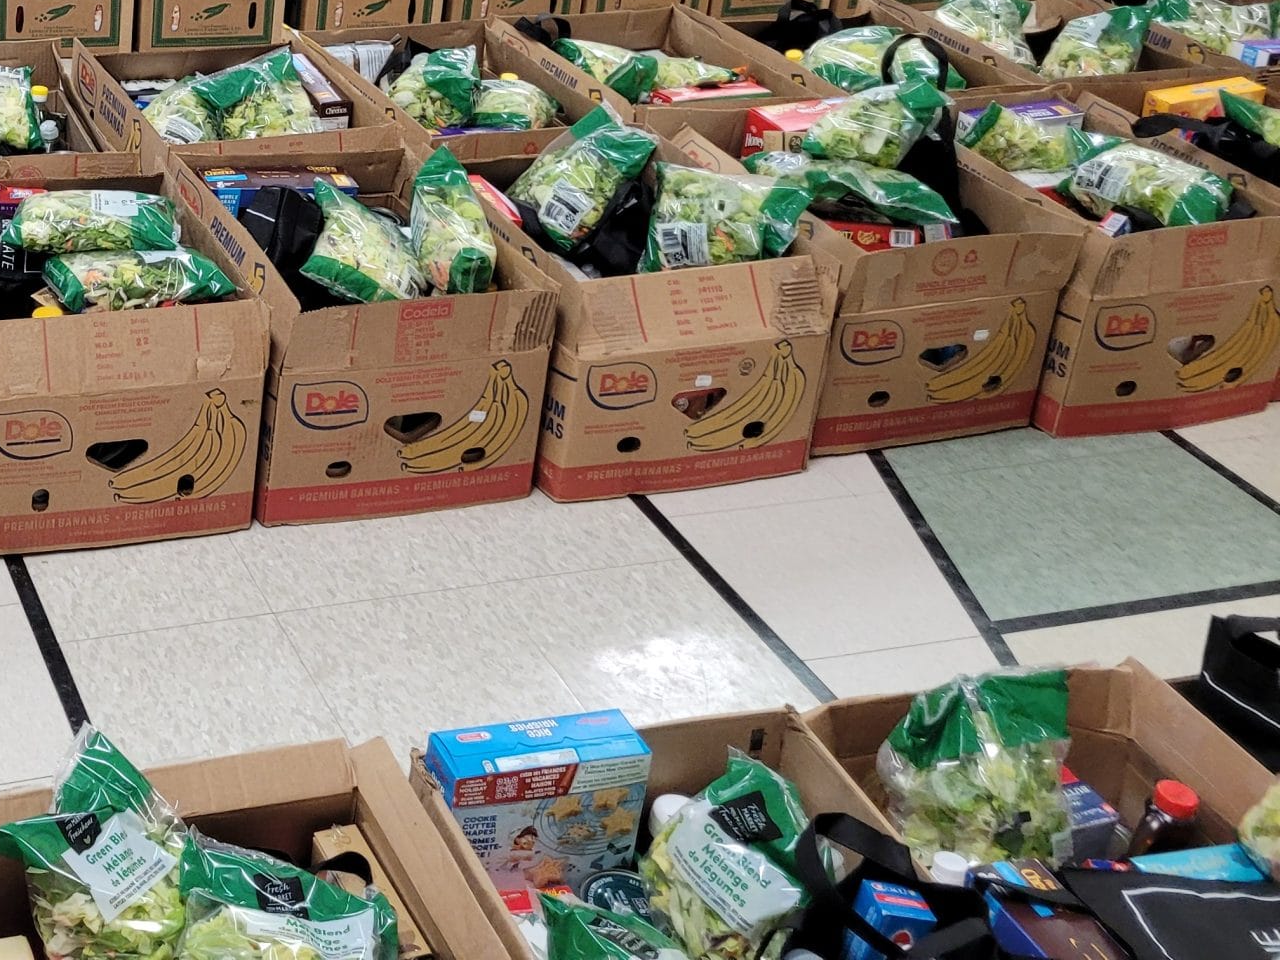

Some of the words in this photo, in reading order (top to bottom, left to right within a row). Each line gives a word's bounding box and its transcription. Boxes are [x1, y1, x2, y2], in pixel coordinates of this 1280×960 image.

[81, 62, 96, 89] Dole
[540, 56, 579, 90] PREMIUM
[103, 83, 127, 122] PREMIUM
[744, 132, 765, 149] Honey
[210, 216, 247, 266] PREMIUM
[402, 303, 450, 319] Codela
[1105, 313, 1150, 332] Dole
[852, 328, 898, 348] Dole
[599, 371, 649, 392] Dole
[136, 398, 171, 408] COMPANY
[305, 390, 360, 412] Dole
[5, 417, 62, 440] Dole
[586, 467, 634, 481] PREMIUM
[634, 463, 683, 477] BANANAS
[694, 456, 742, 470] PREMIUM
[743, 450, 784, 464] BANANAS
[298, 489, 349, 503] PREMIUM
[350, 484, 401, 499] BANANAS
[413, 478, 462, 492] PREMIUM
[462, 472, 510, 488] BANANAS
[3, 518, 56, 533] PREMIUM
[57, 513, 111, 527] BANANAS
[124, 507, 176, 521] PREMIUM
[176, 500, 227, 516] BANANAS
[508, 718, 560, 732] KRISPIES
[528, 727, 553, 738] RICE
[530, 780, 553, 789] MAISON
[531, 773, 560, 782] VACANCES
[460, 786, 487, 794] HOLIDAY
[462, 822, 497, 830] CUTTER
[463, 814, 497, 823] COOKIE
[741, 808, 759, 833] MARKET
[747, 803, 767, 831] Fresh
[85, 843, 114, 866] Green
[471, 844, 503, 852] PORTE-
[111, 876, 121, 889] de
[119, 855, 147, 882] légumes
[701, 843, 749, 893] Mélange
[264, 883, 291, 894] Fresh
[688, 849, 700, 864] de
[699, 859, 747, 909] légumes
